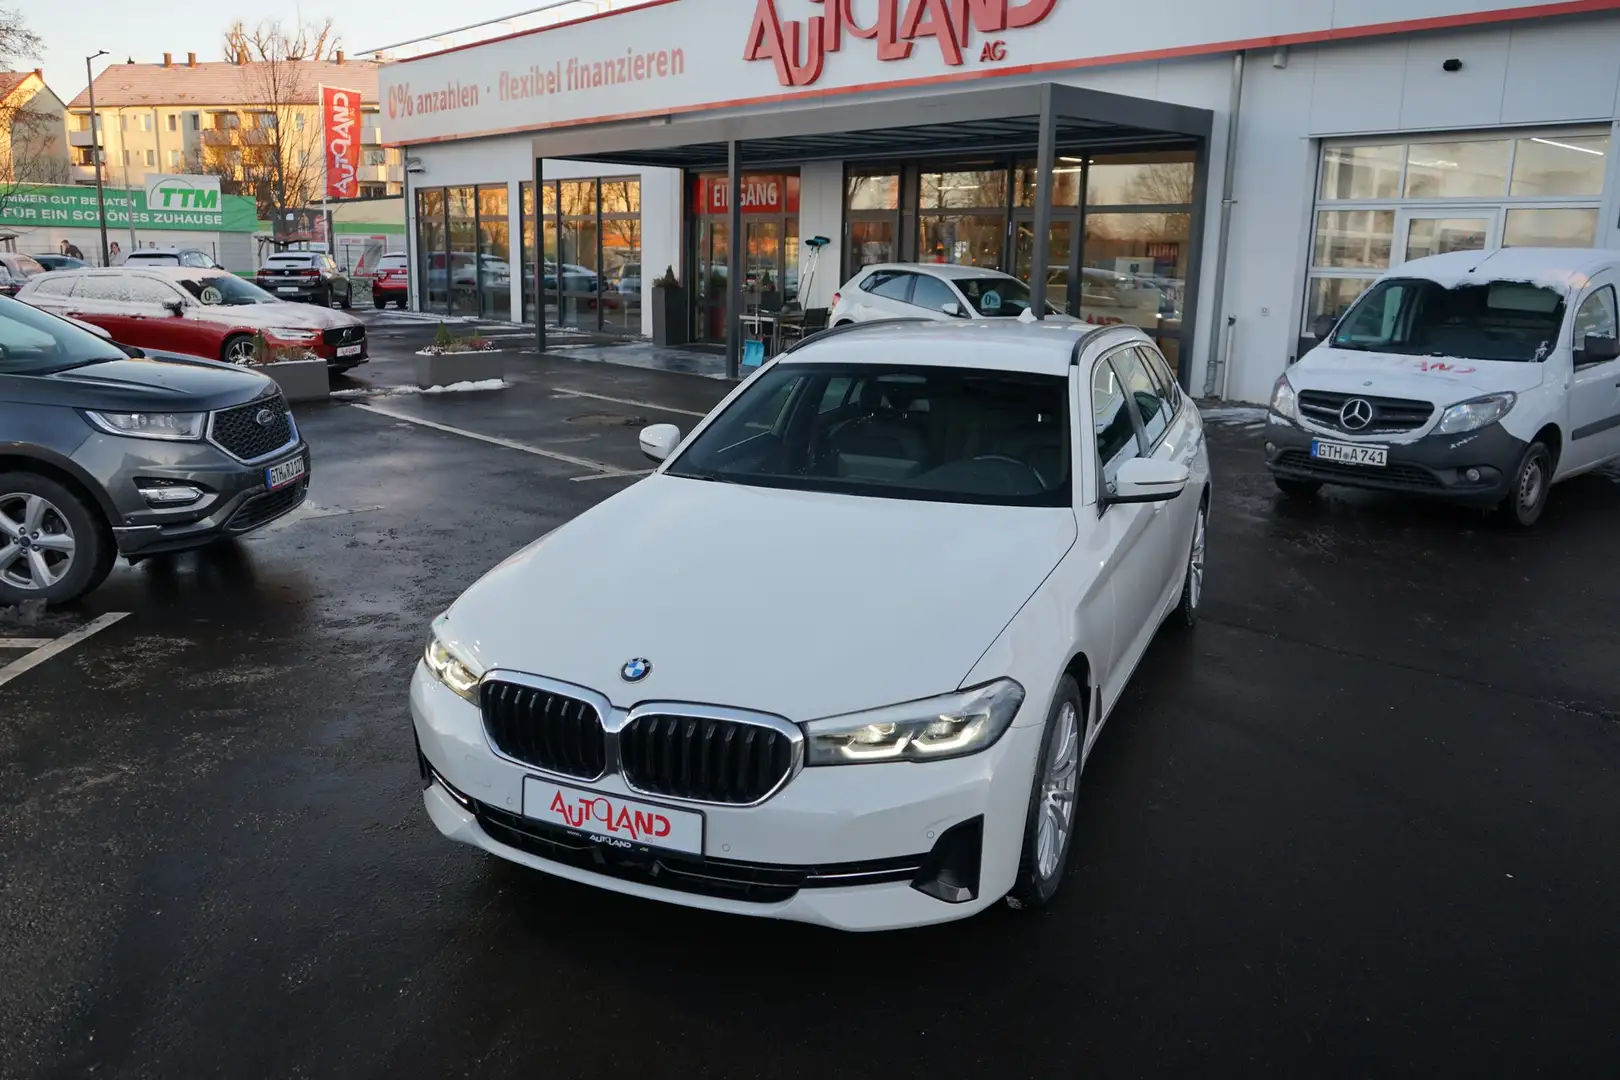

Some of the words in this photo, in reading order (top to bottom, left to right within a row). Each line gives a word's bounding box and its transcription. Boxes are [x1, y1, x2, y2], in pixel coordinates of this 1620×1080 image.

[979, 40, 1007, 62] AG
[387, 81, 413, 119] 0%
[417, 82, 478, 114] anzahlen
[499, 62, 561, 101] flexibel
[566, 47, 684, 91] finanzieren
[331, 92, 354, 194] AUTOLAND
[51, 195, 76, 205] GUT
[81, 197, 136, 207] BEATEN
[159, 188, 218, 208] TTM
[714, 183, 777, 206] EIGANG
[3, 206, 36, 219] FÜR
[42, 210, 68, 220] EIN
[154, 213, 222, 225] ZUHAUSE
[1319, 444, 1342, 459] GTH
[271, 465, 283, 484] GTH
[550, 790, 671, 840] AUTOLAND
[589, 834, 632, 849] AUTOLAND
